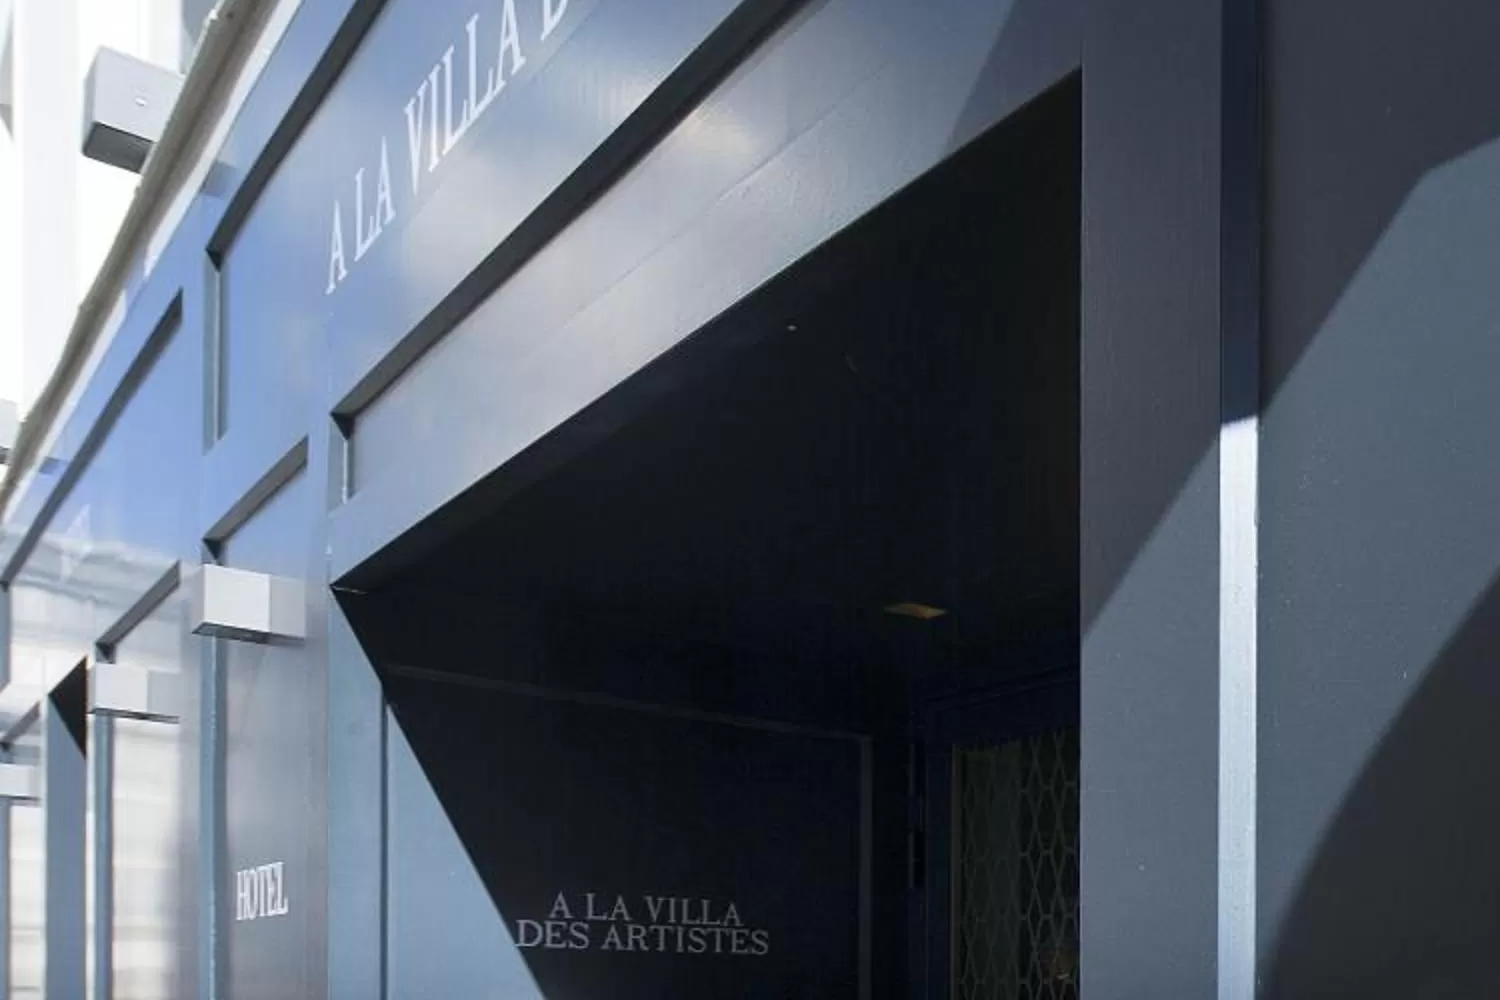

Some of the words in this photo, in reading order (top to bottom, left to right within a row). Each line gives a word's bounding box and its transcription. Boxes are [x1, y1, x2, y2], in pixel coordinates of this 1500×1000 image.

[325, 200, 348, 295] A
[354, 135, 397, 262] LA
[235, 861, 289, 921] HOTEL
[550, 890, 574, 919] A
[586, 892, 633, 921] LA
[644, 896, 745, 927] VILLA
[515, 919, 590, 949] DES
[601, 924, 769, 955] ARTISTES
